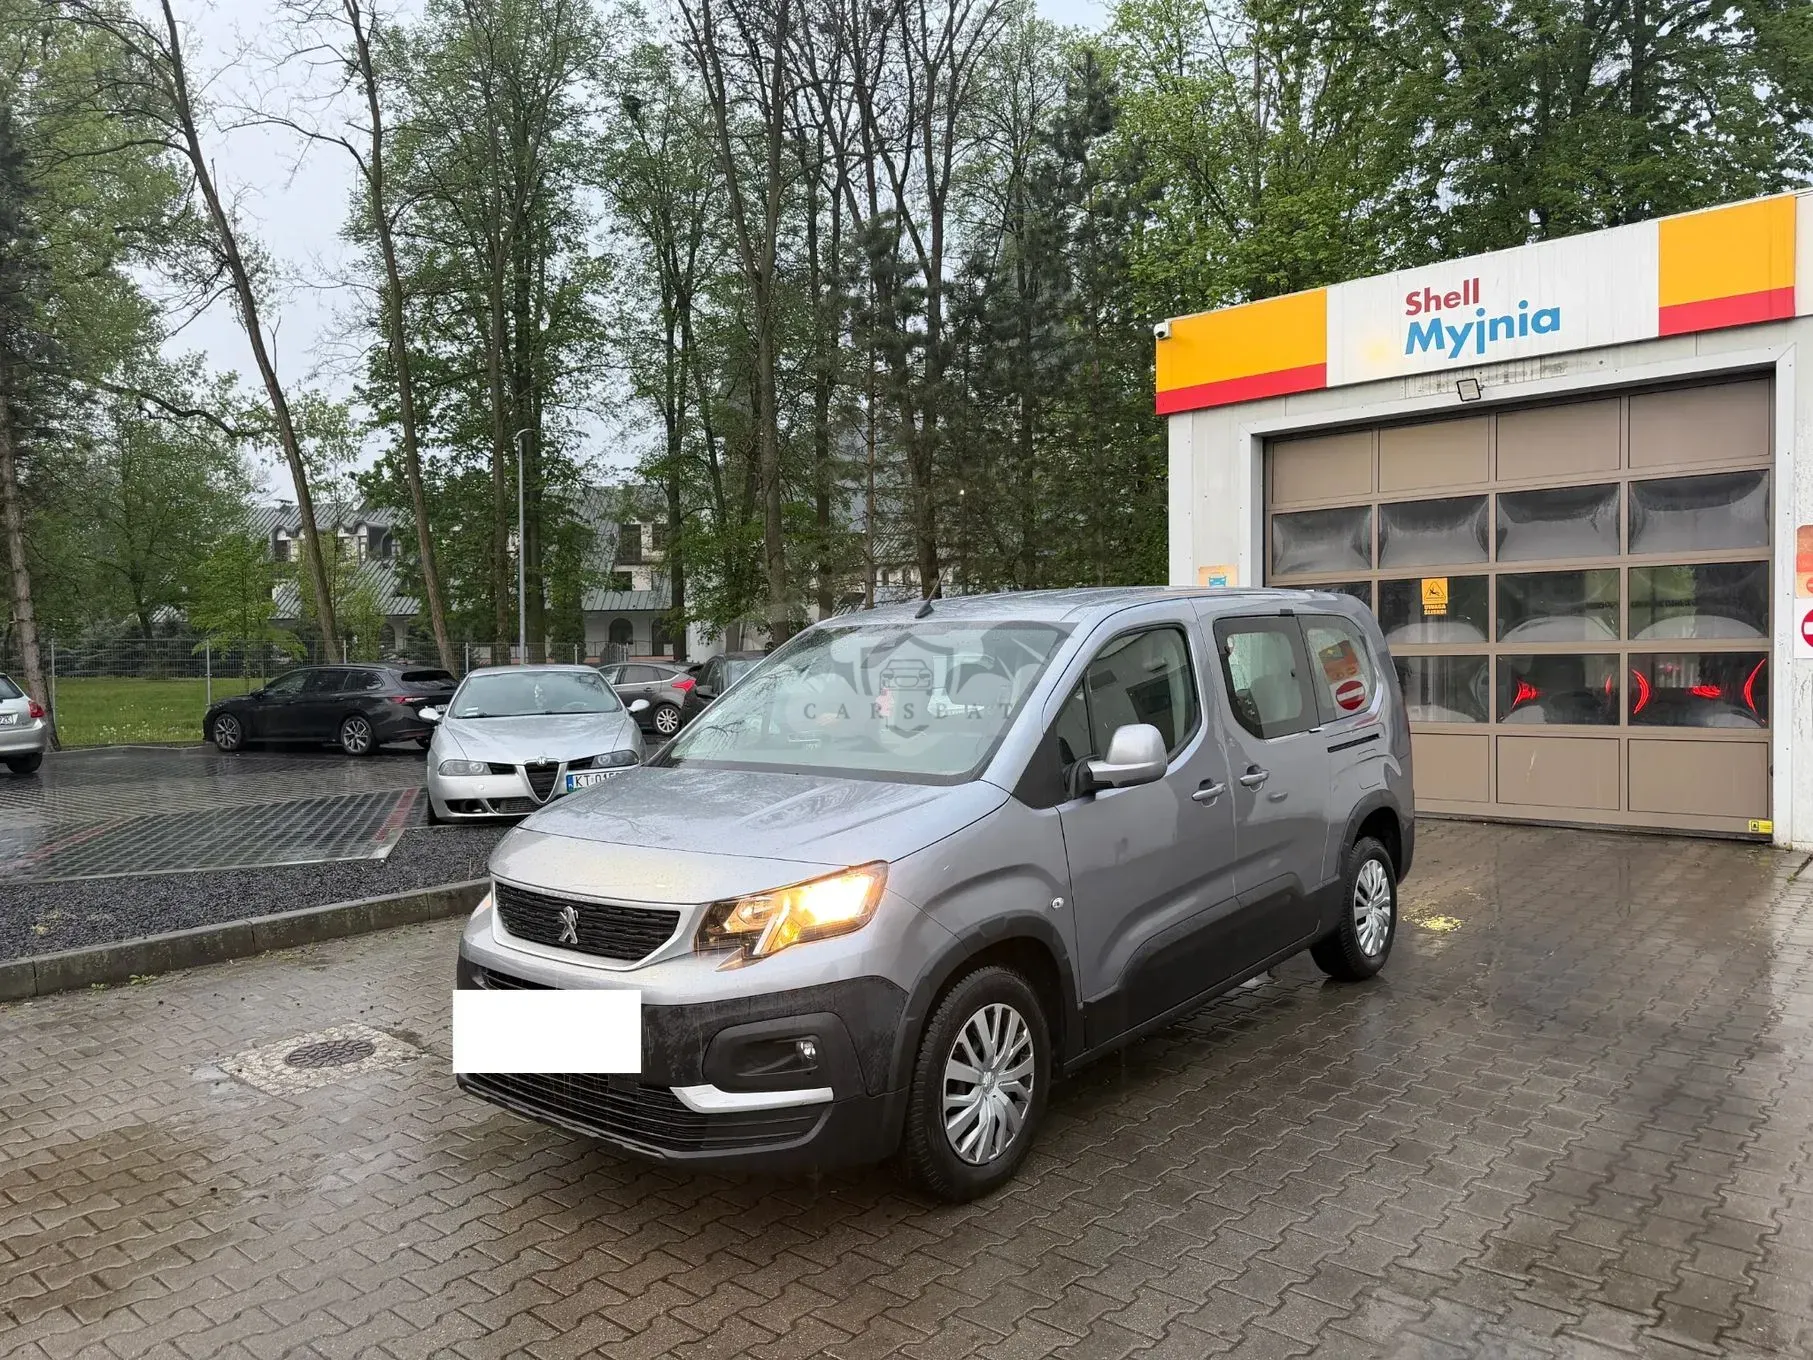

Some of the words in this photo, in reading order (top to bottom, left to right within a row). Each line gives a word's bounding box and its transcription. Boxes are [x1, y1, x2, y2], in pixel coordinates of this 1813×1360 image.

[1405, 277, 1480, 316] Shell
[1405, 300, 1561, 359] Myjnia
[575, 774, 591, 786] KT
